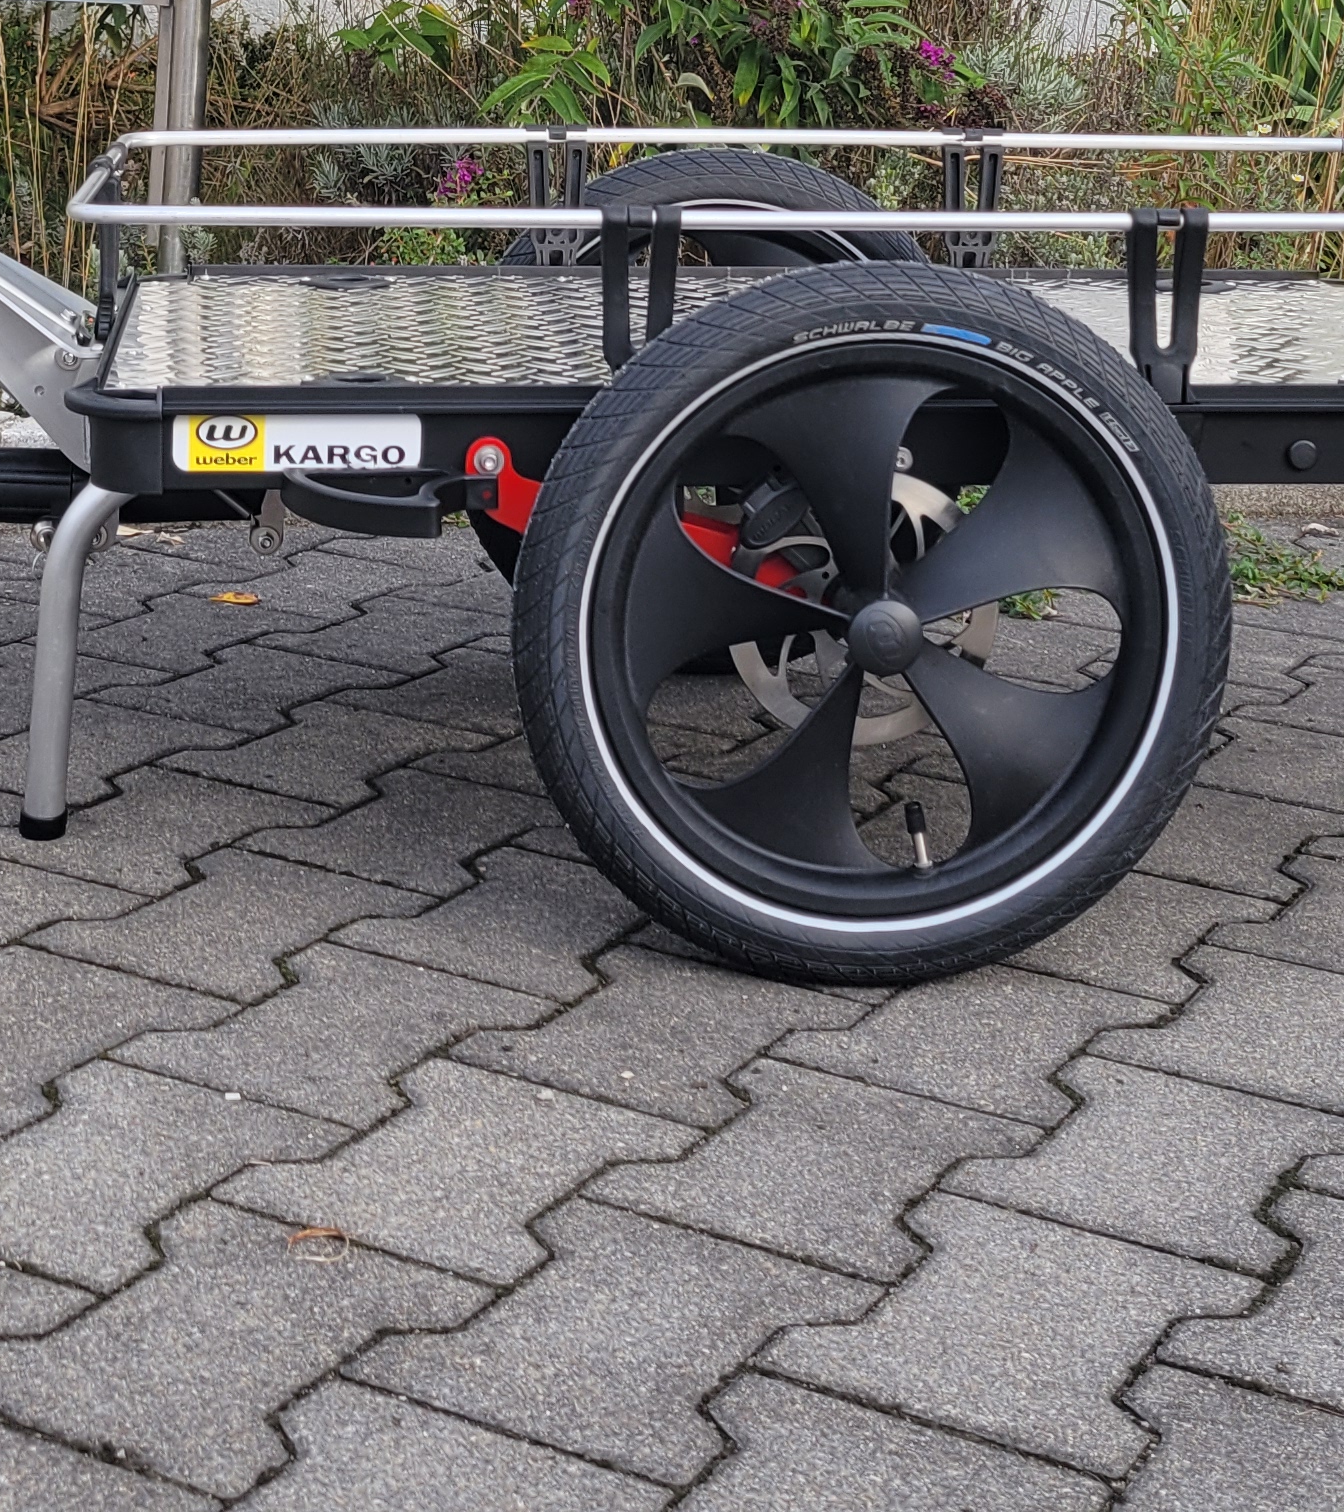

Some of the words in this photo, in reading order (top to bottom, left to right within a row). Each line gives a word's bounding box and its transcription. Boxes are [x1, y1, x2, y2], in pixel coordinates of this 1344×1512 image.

[793, 320, 916, 344] SCHWALBE
[994, 341, 1035, 363] BIG
[1036, 362, 1101, 409] APPLE
[195, 452, 258, 466] weber
[273, 444, 406, 466] KARGO
